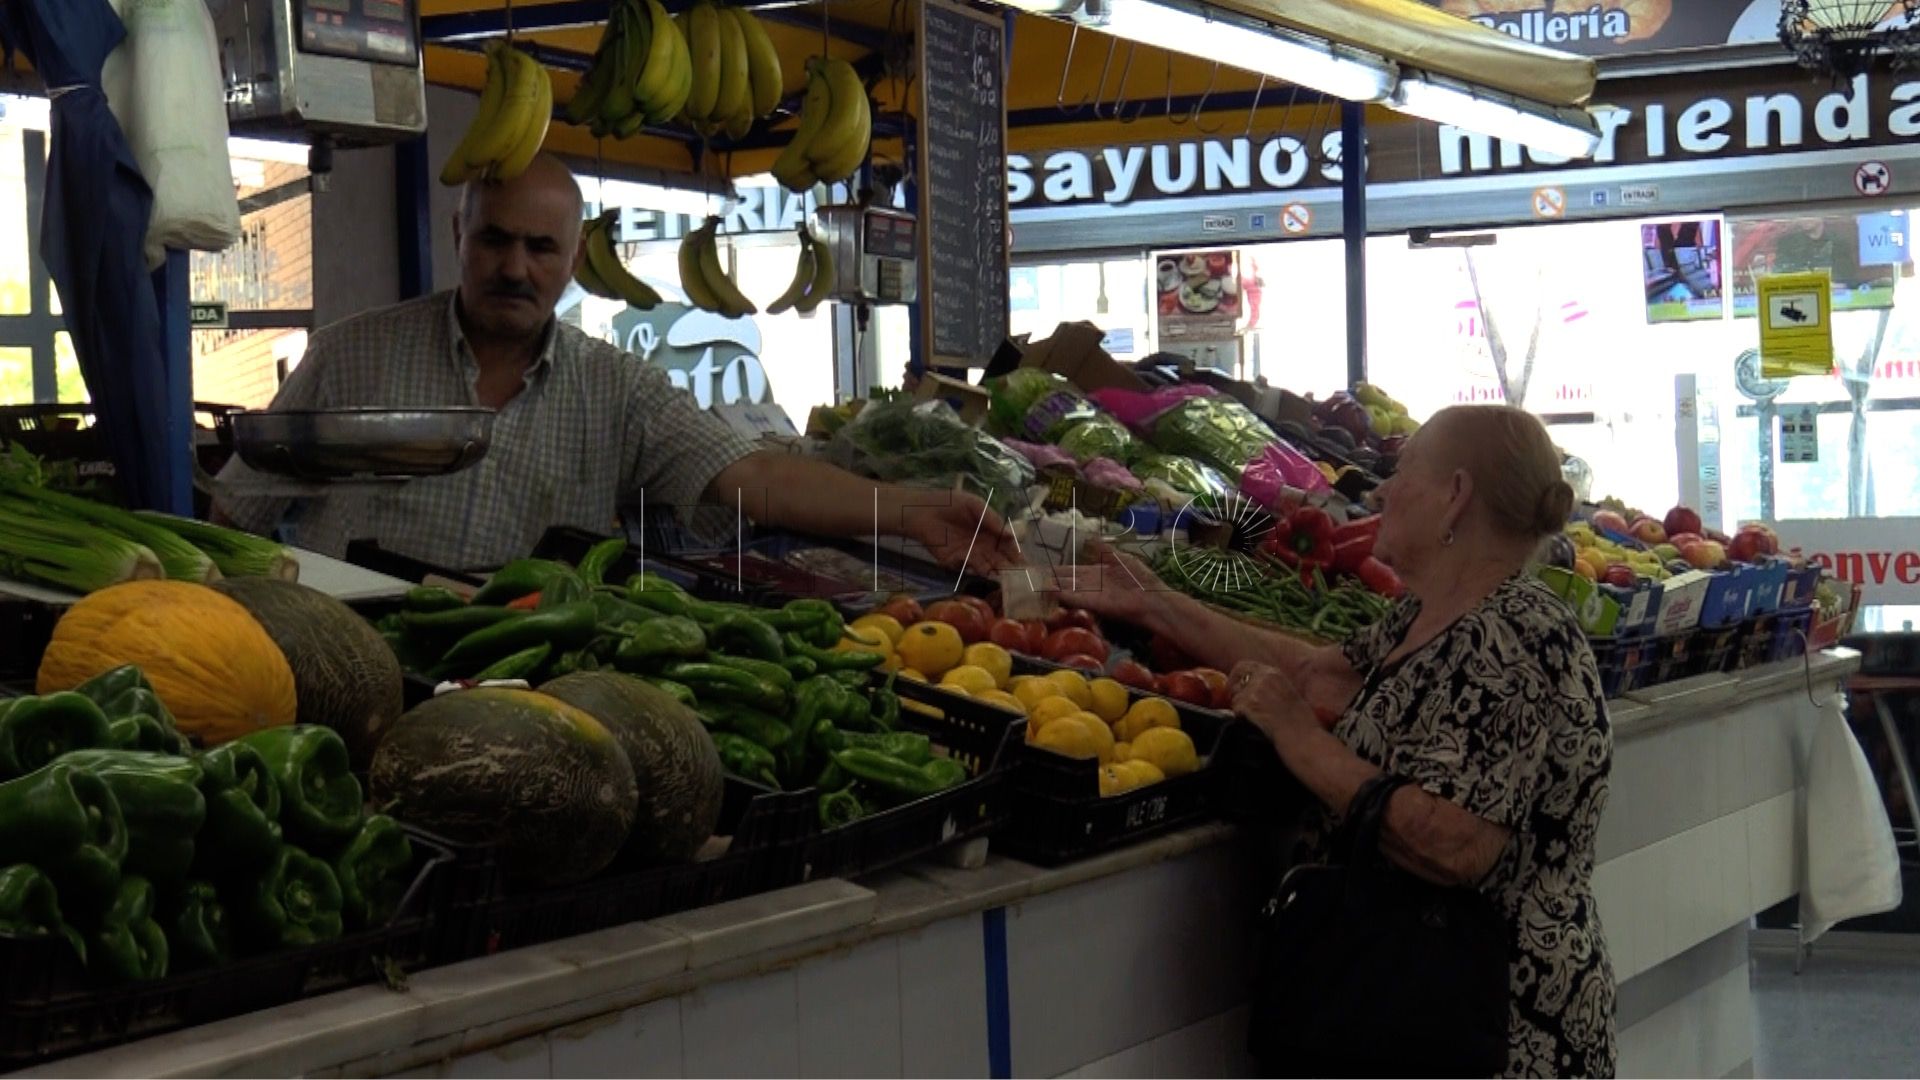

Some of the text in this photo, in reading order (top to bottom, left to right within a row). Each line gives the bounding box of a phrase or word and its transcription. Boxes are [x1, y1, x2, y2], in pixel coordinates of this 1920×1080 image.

[1470, 5, 1629, 44] ollería
[1623, 190, 1655, 200] ENTRADA
[1205, 218, 1234, 229] ENTRADA
